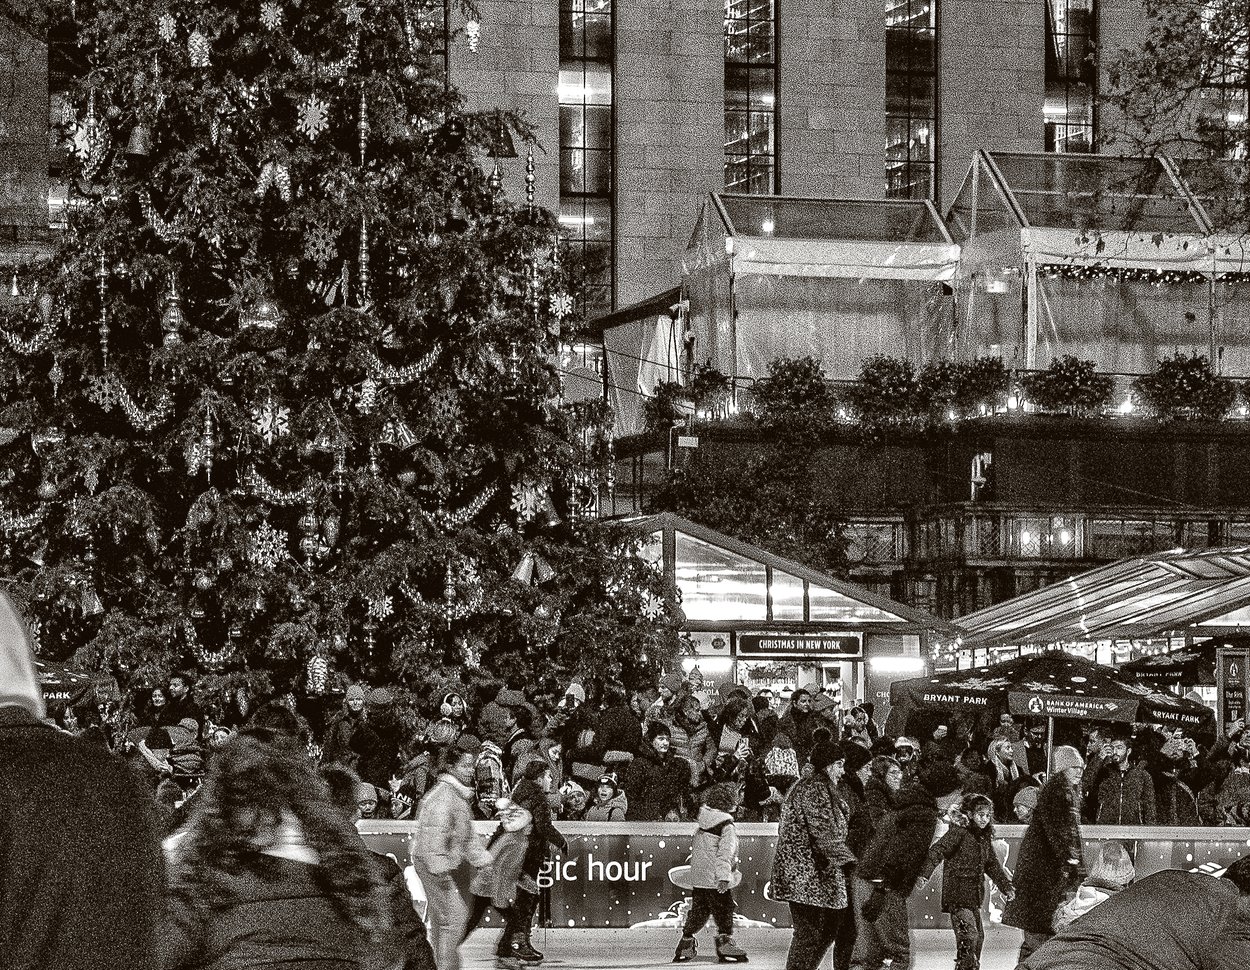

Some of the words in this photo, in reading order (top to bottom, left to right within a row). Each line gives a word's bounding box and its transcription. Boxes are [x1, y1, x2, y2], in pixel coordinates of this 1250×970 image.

[759, 640, 795, 649] CHRISTMAS
[796, 641, 804, 649] IN
[806, 641, 820, 650] NEW
[823, 641, 840, 650] YORK
[923, 694, 960, 703] BRYANT
[963, 696, 987, 705] PARK
[1075, 702, 1104, 710] AMERICA
[1067, 708, 1088, 716] Village
[1152, 710, 1178, 720] BRYANT
[1181, 714, 1200, 724] PARK
[588, 853, 652, 882] hour
